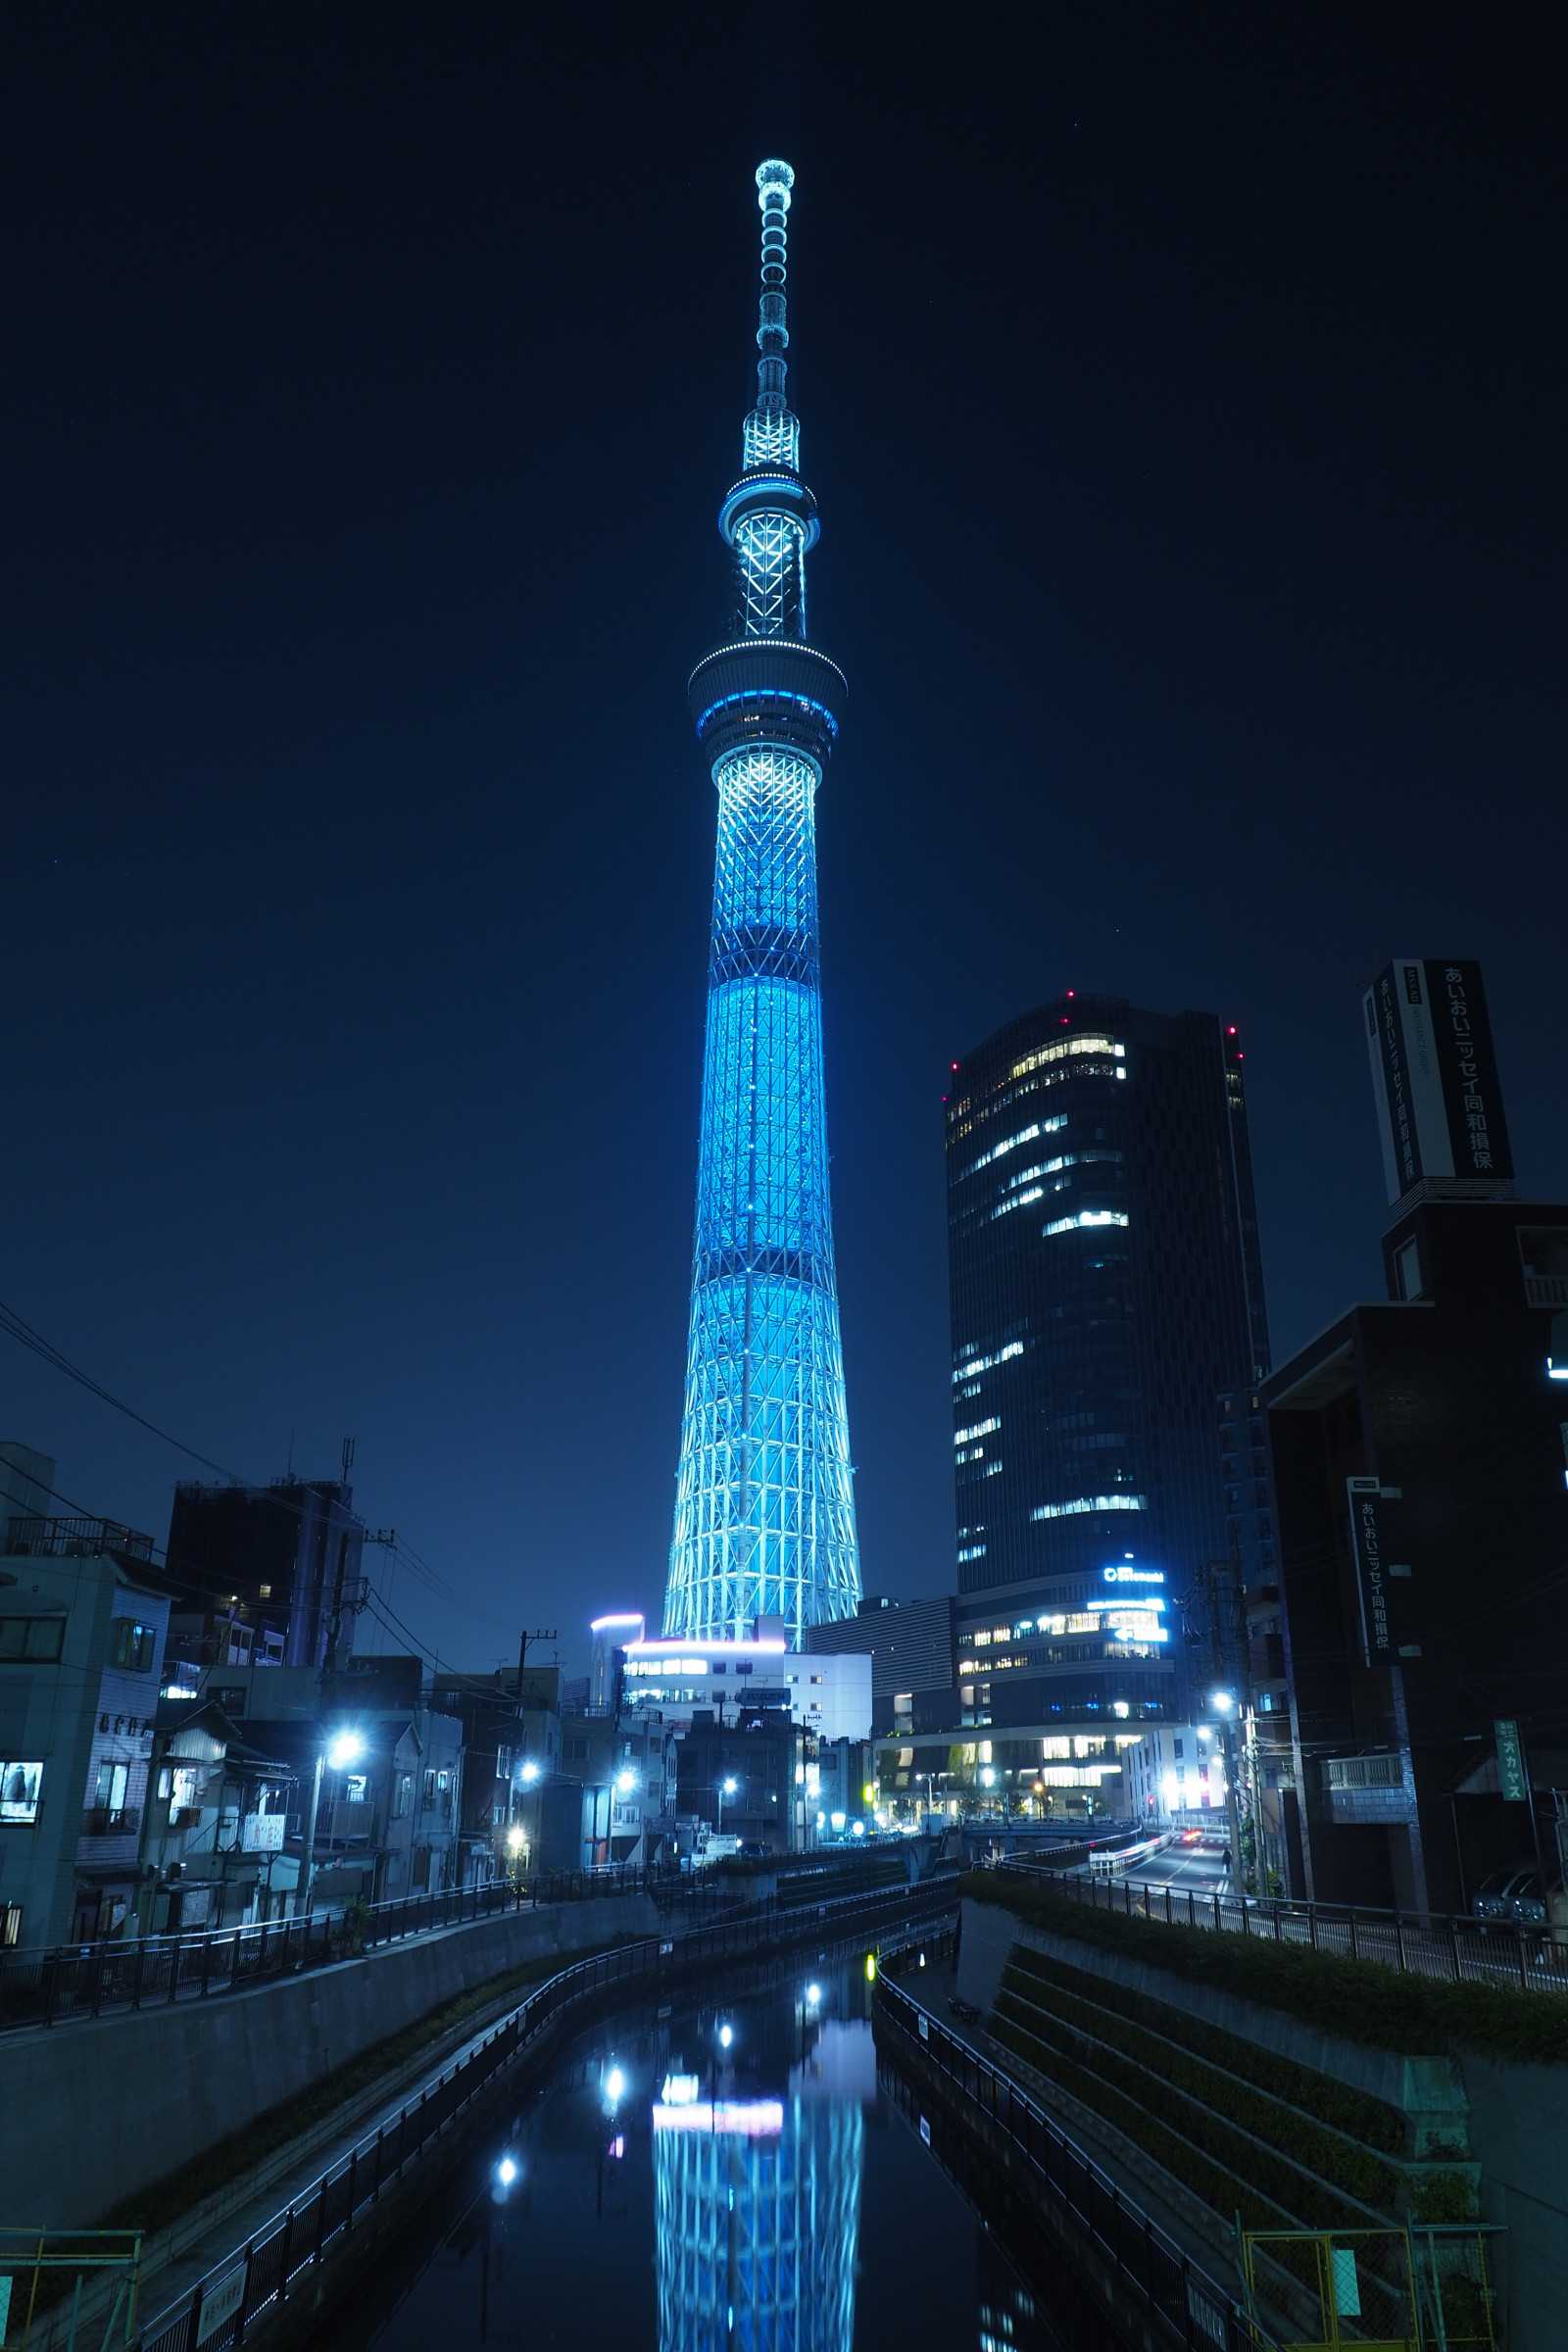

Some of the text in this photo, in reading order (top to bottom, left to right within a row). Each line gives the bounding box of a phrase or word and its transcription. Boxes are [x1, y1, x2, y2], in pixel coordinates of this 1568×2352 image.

[1412, 1006, 1427, 1050] INSURANCE
[1419, 1049, 1431, 1078] GROUP
[1444, 966, 1494, 1170] あいおいニッセイ同和損保
[1361, 1502, 1390, 1649] あいおいニッセイ同和損保
